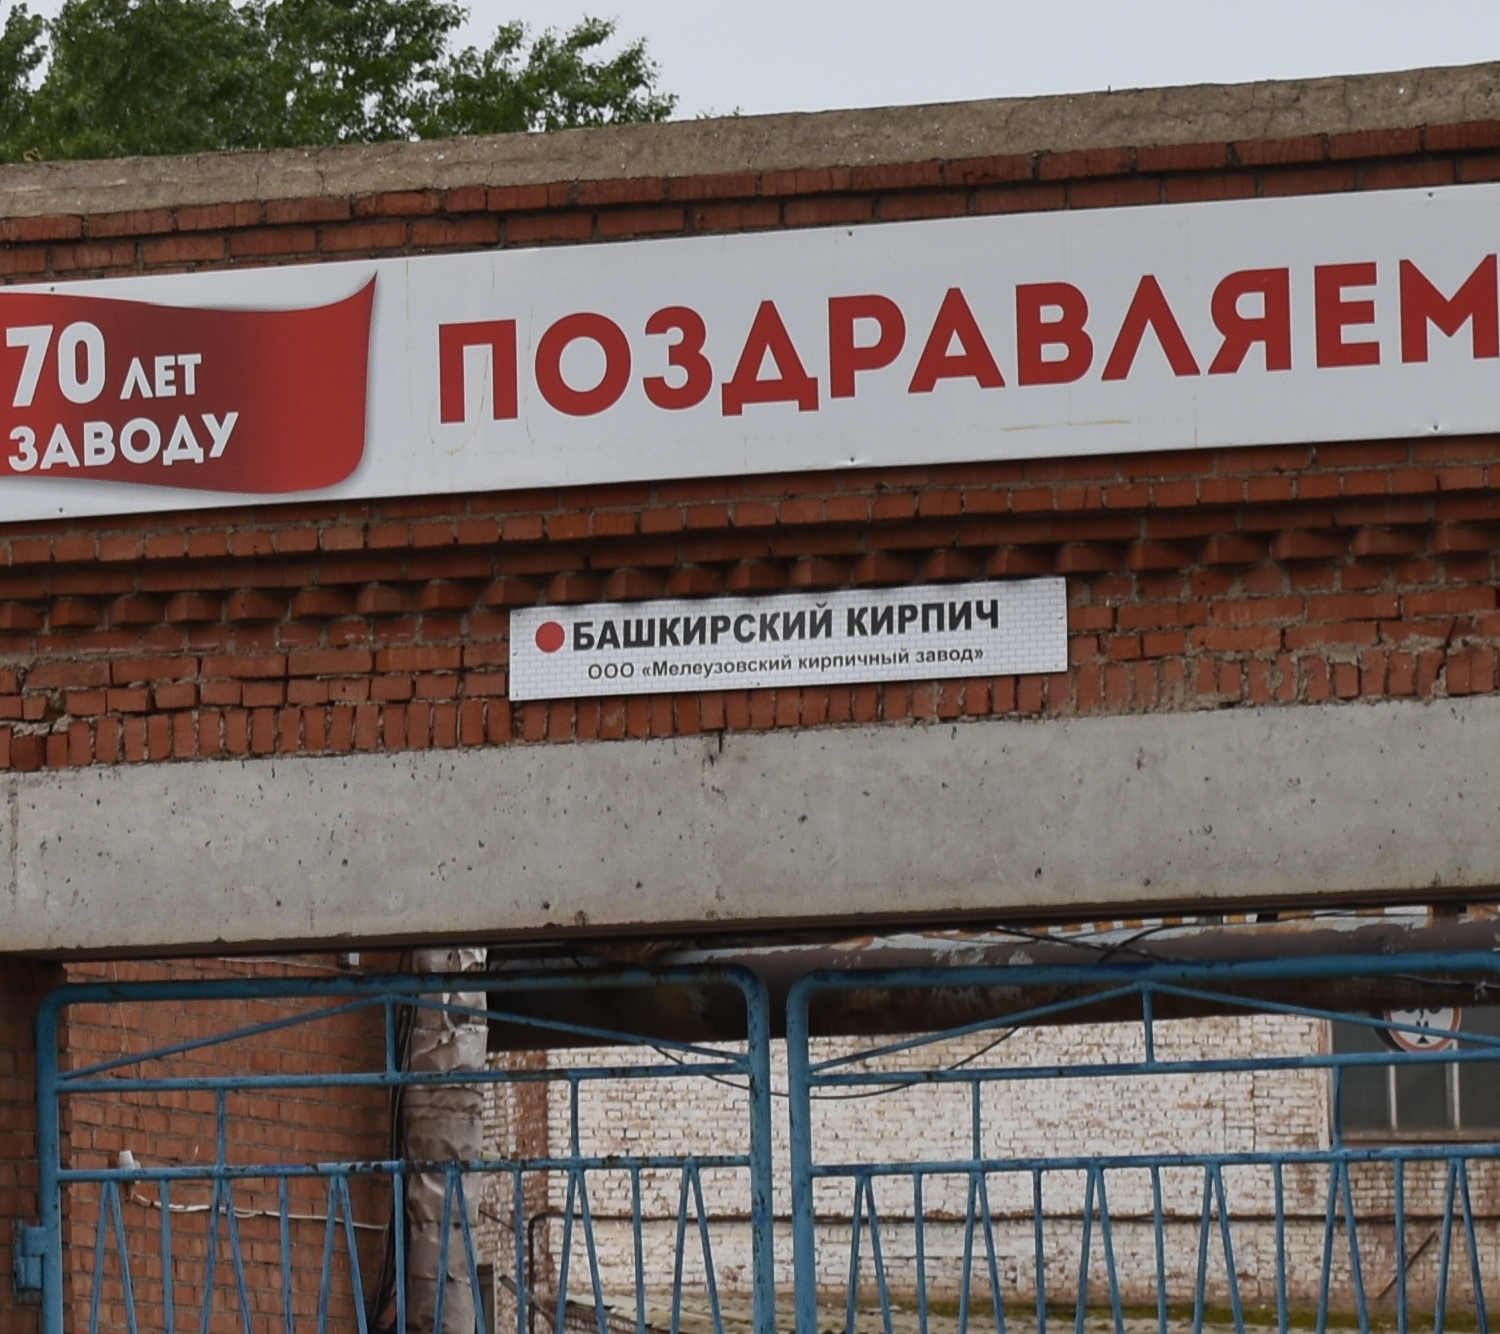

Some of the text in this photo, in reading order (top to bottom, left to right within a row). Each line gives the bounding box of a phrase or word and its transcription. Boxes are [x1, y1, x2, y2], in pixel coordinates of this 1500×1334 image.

[6, 321, 202, 407] 70 ЛЕТ
[8, 412, 239, 471] ЗАВОДУ
[572, 599, 1000, 652] БАШКИРСКИЙ КИРПИЧ
[588, 647, 984, 680] ООО «Мелеузовский кирпичный завод»
